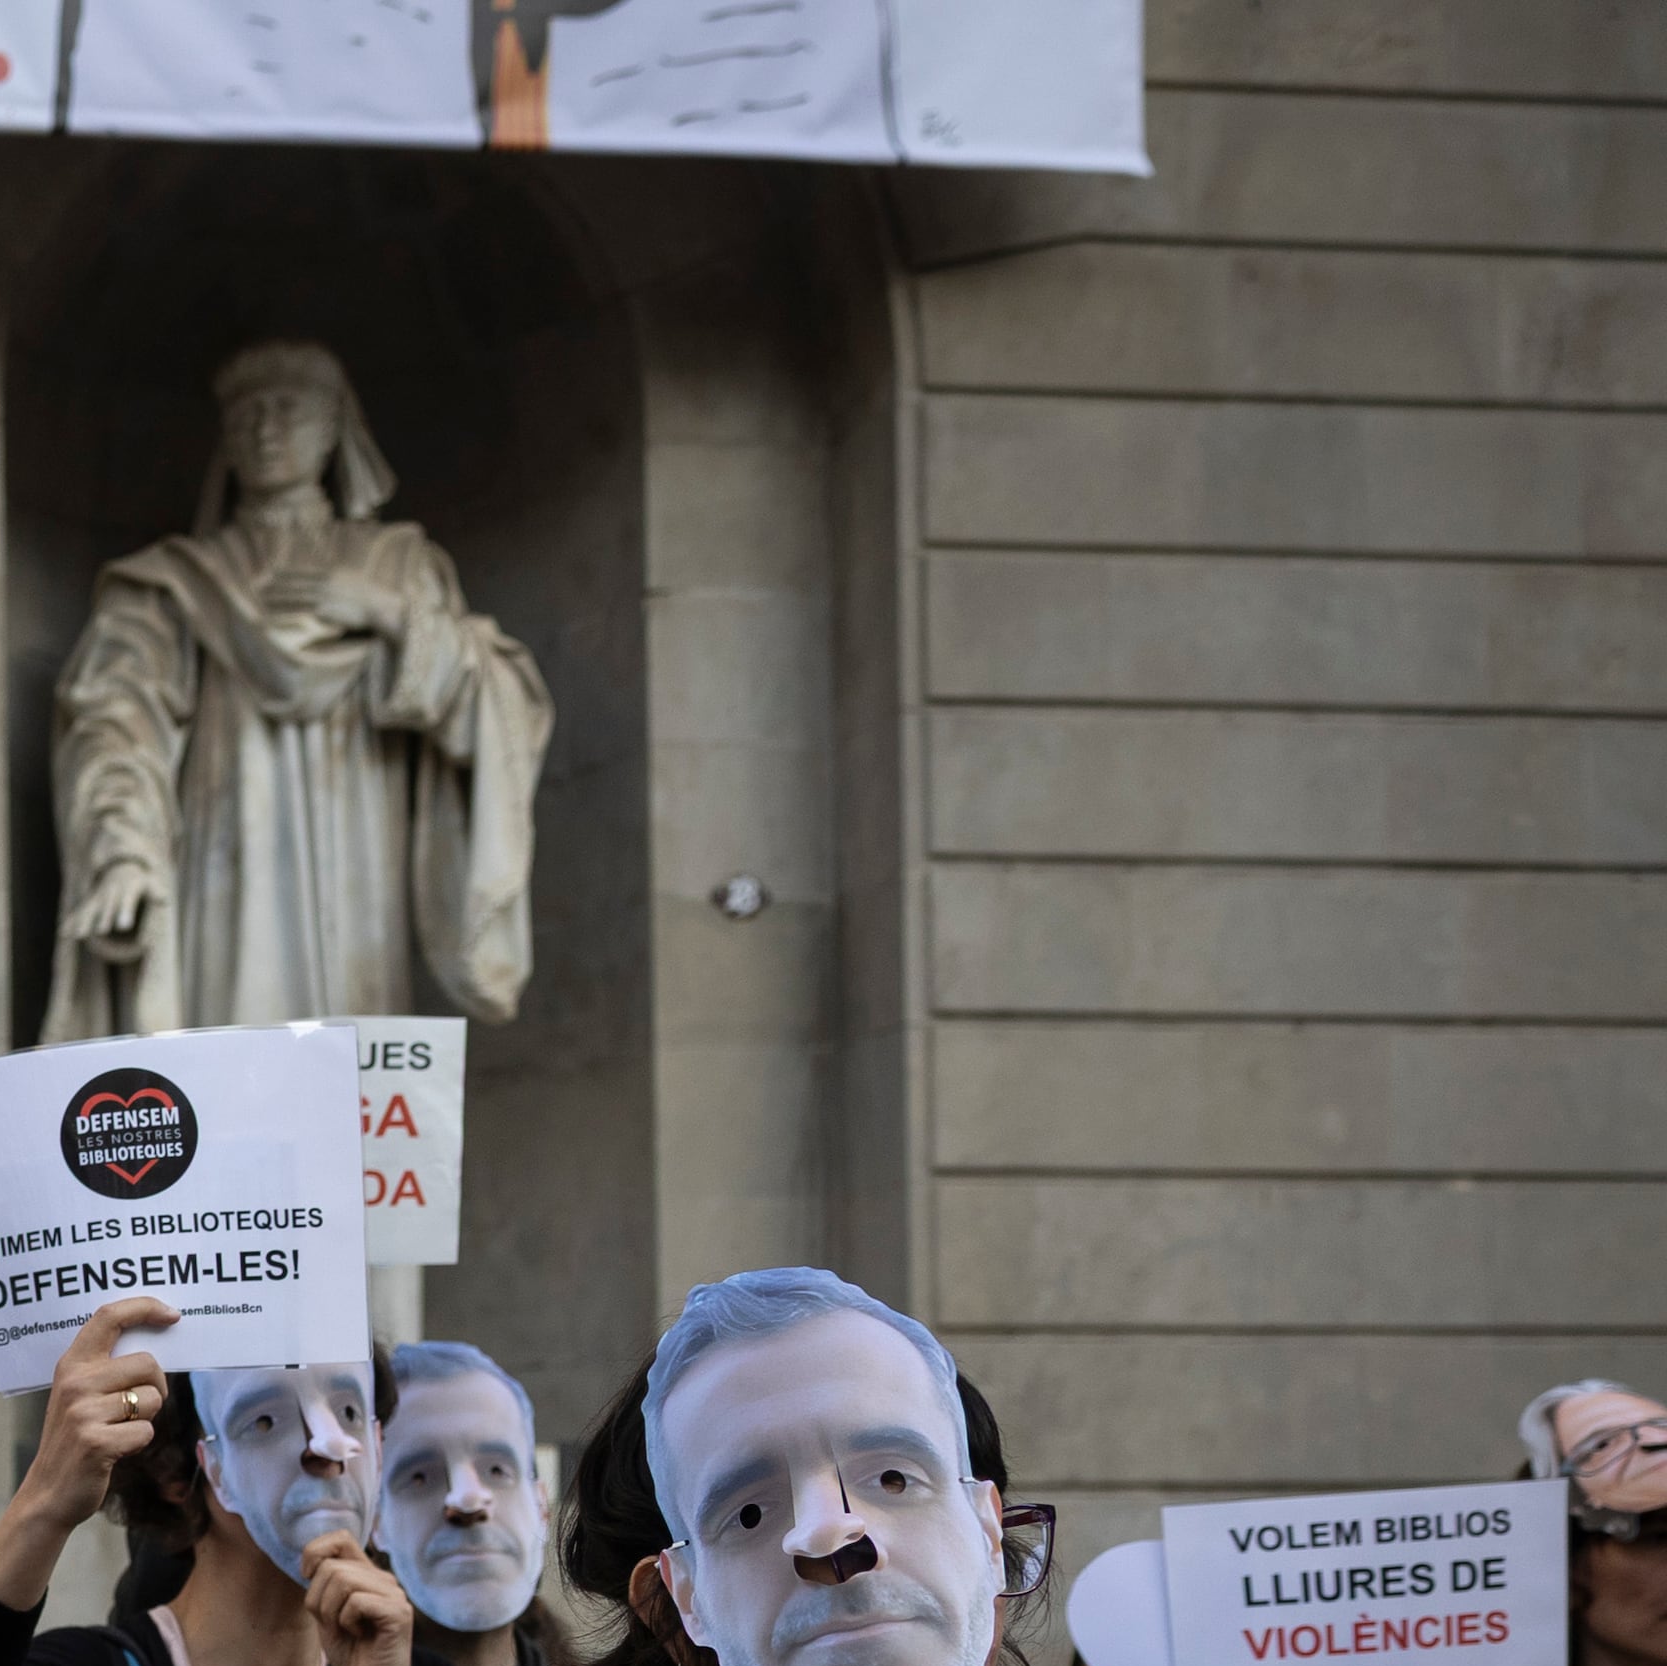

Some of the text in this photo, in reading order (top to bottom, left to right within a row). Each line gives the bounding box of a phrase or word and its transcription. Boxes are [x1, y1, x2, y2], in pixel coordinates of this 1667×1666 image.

[76, 1106, 180, 1133] DEFENSEM
[78, 1128, 181, 1148] LES NOSTRES
[79, 1142, 183, 1165] BIBLIOTEQUES
[72, 1219, 121, 1243] LES
[131, 1208, 323, 1236] BIBLIOTEQUES
[1230, 1510, 1510, 1552] VOLEM BIBLIOS
[1244, 1558, 1505, 1606] LLIURES DE
[1244, 1611, 1508, 1659] VIOLÈNCIES
